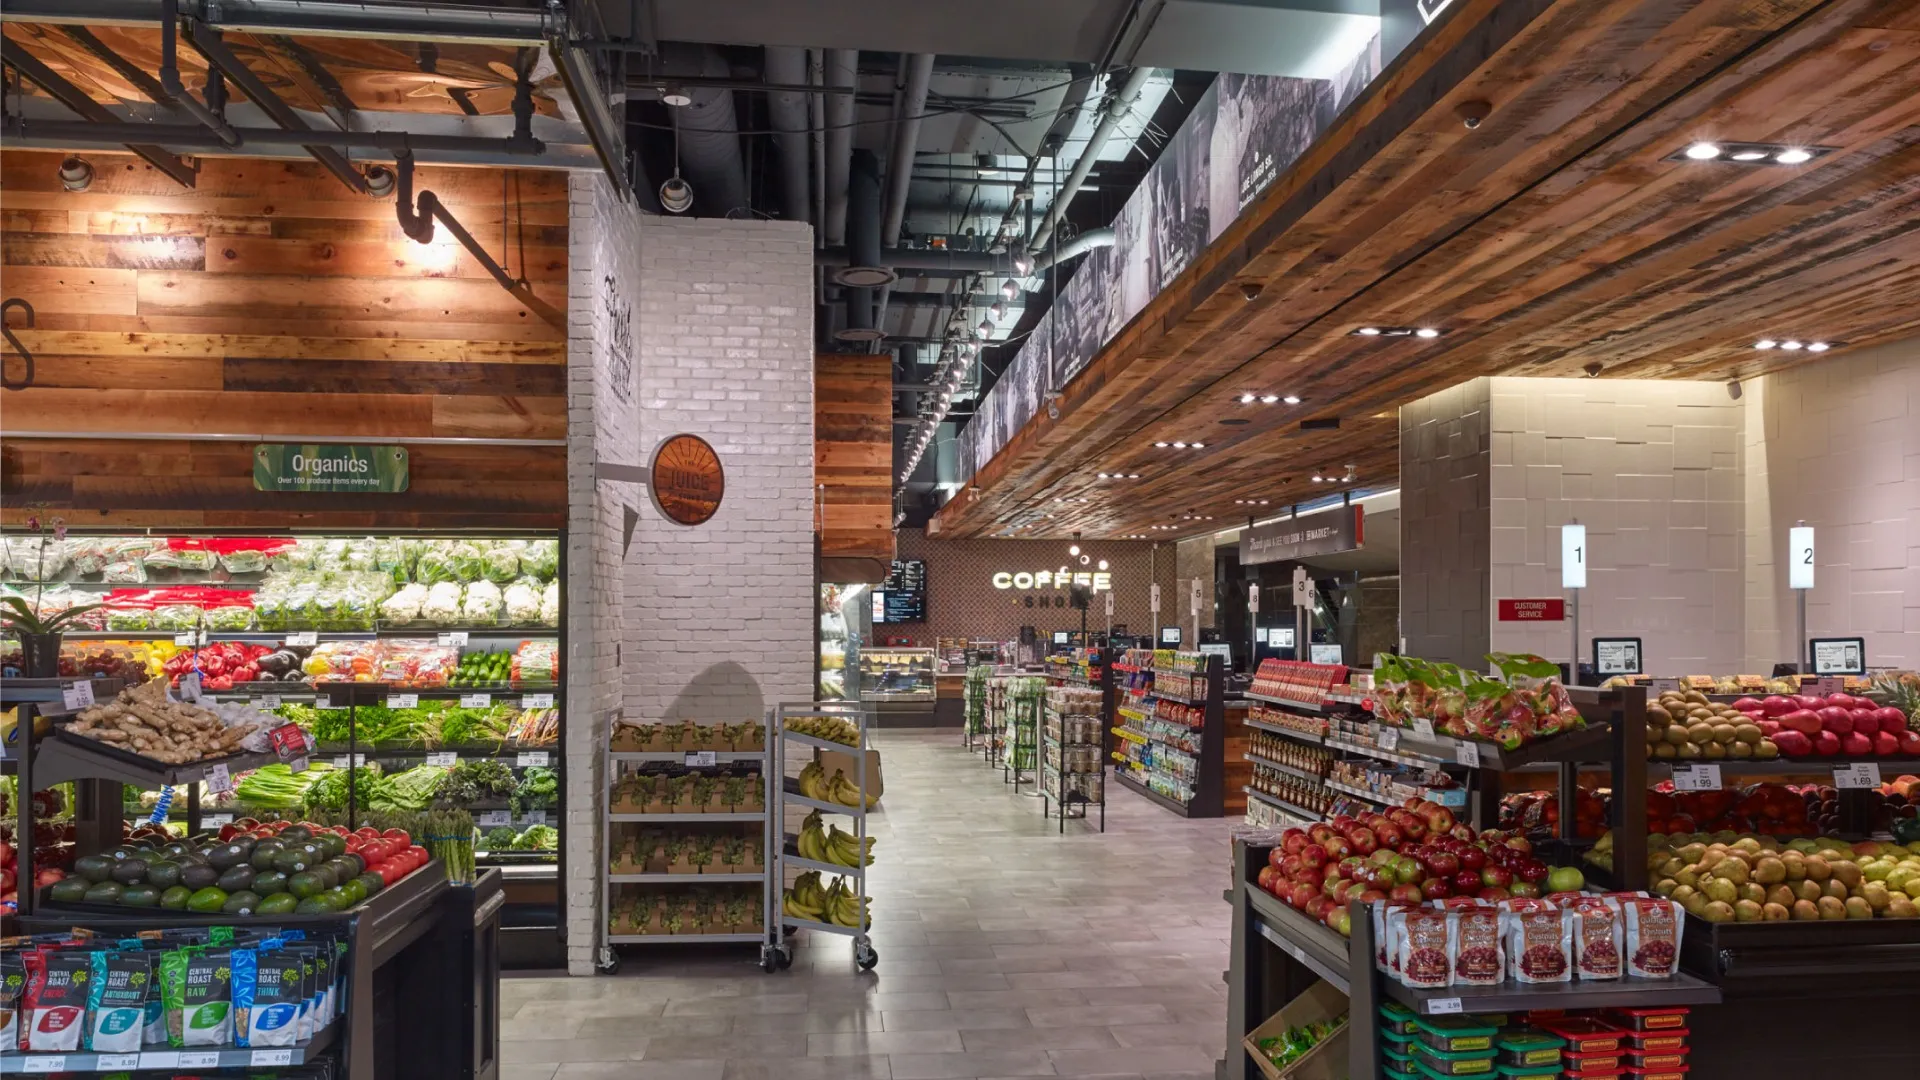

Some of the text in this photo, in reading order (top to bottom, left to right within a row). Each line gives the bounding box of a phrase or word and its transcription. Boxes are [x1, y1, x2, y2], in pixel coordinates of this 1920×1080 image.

[292, 454, 368, 476] Organics
[277, 476, 292, 484] Over
[294, 476, 305, 484] 100
[306, 477, 332, 486] produce
[350, 478, 368, 486] every
[368, 478, 380, 487] day
[668, 470, 710, 492] JUICE
[1249, 536, 1263, 551] Thank
[1264, 538, 1272, 553] you
[1290, 534, 1300, 544] SOON
[1574, 547, 1582, 563] 1
[1804, 548, 1814, 564] 2
[992, 572, 1112, 590] COFFEE
[1298, 580, 1305, 592] 3
[1196, 589, 1202, 598] 5
[1308, 589, 1314, 598] 6
[1024, 596, 1070, 608] SHO
[1252, 594, 1258, 603] 8
[1514, 602, 1547, 610] CUSTOMER
[1692, 779, 1712, 788] 1.99
[1852, 777, 1871, 785] 1.69
[1527, 932, 1559, 941] Chestnuts
[189, 967, 213, 975] CENTRAL
[47, 978, 70, 986] ROAST
[107, 978, 128, 987] ROAST
[187, 975, 213, 984] ROAST
[258, 975, 281, 984] ROAST
